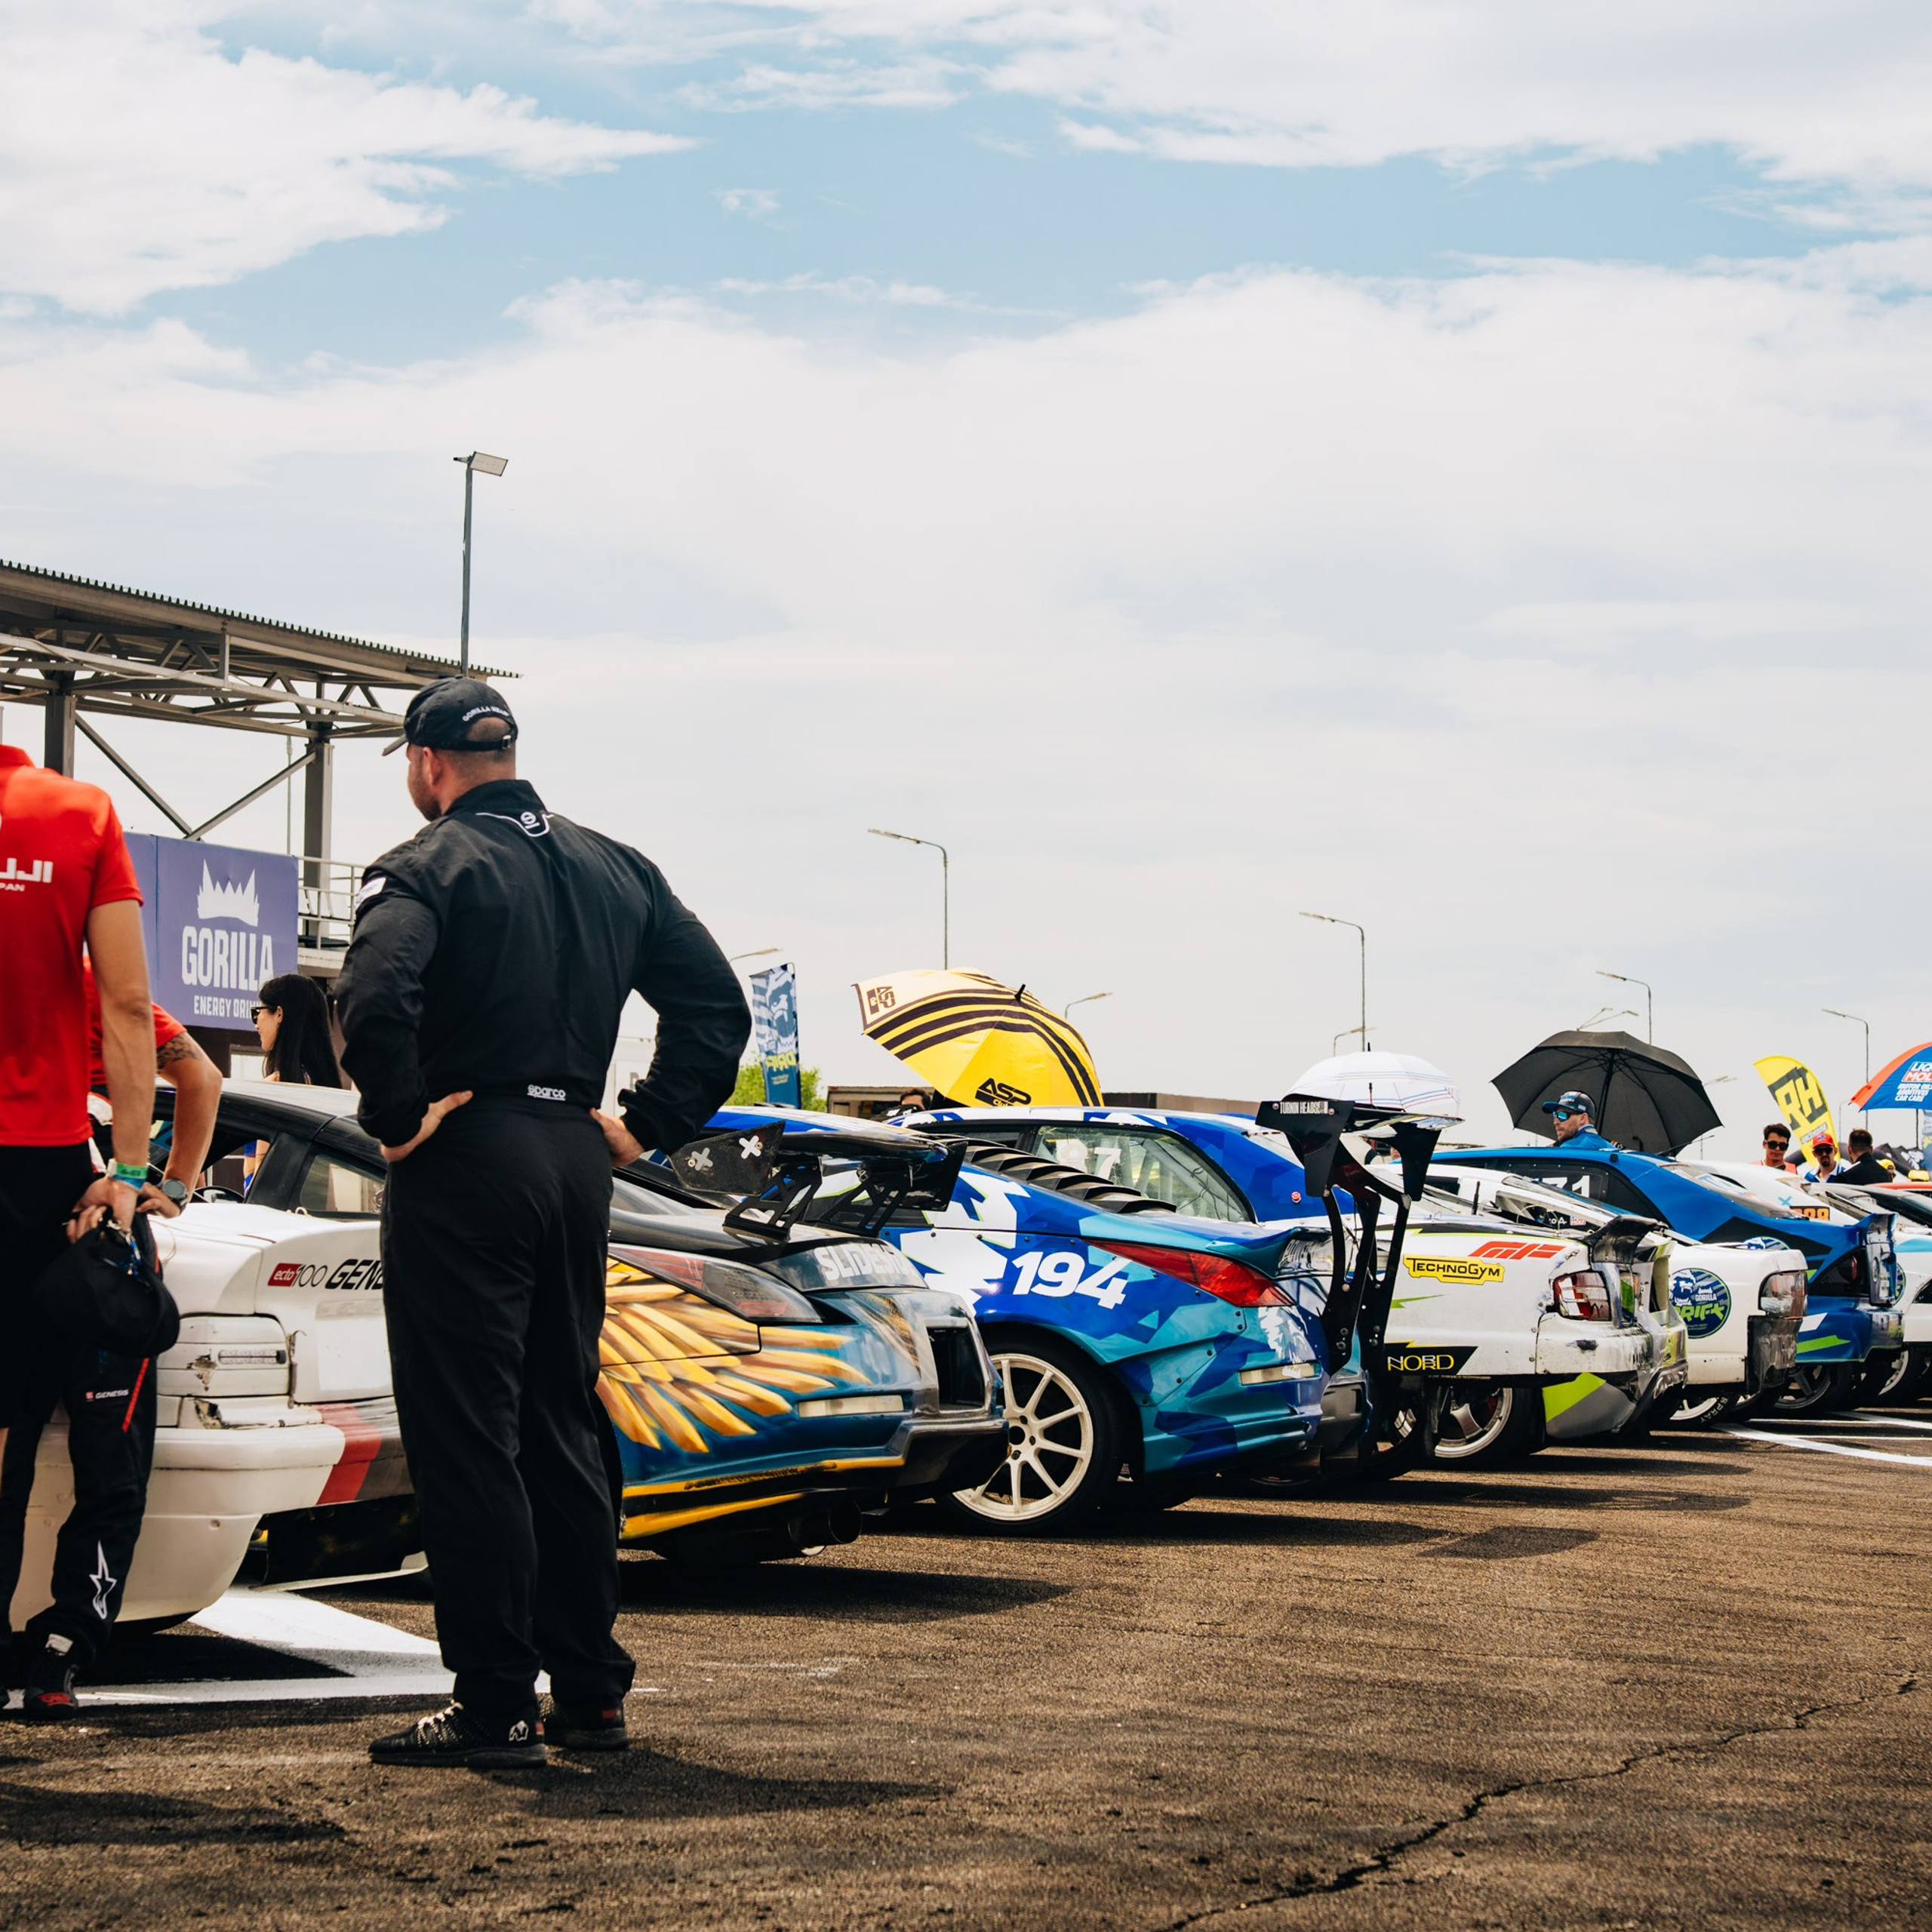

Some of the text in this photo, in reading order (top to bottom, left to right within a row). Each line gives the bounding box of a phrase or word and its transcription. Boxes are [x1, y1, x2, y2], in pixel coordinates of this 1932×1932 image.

[182, 925, 274, 992] GORILLA
[194, 995, 232, 1018] ENERGY
[978, 1078, 1032, 1105] ASP
[1011, 1251, 1132, 1309] 194
[1695, 1293, 1718, 1302] GORILLA
[1387, 1354, 1455, 1371] NORD
